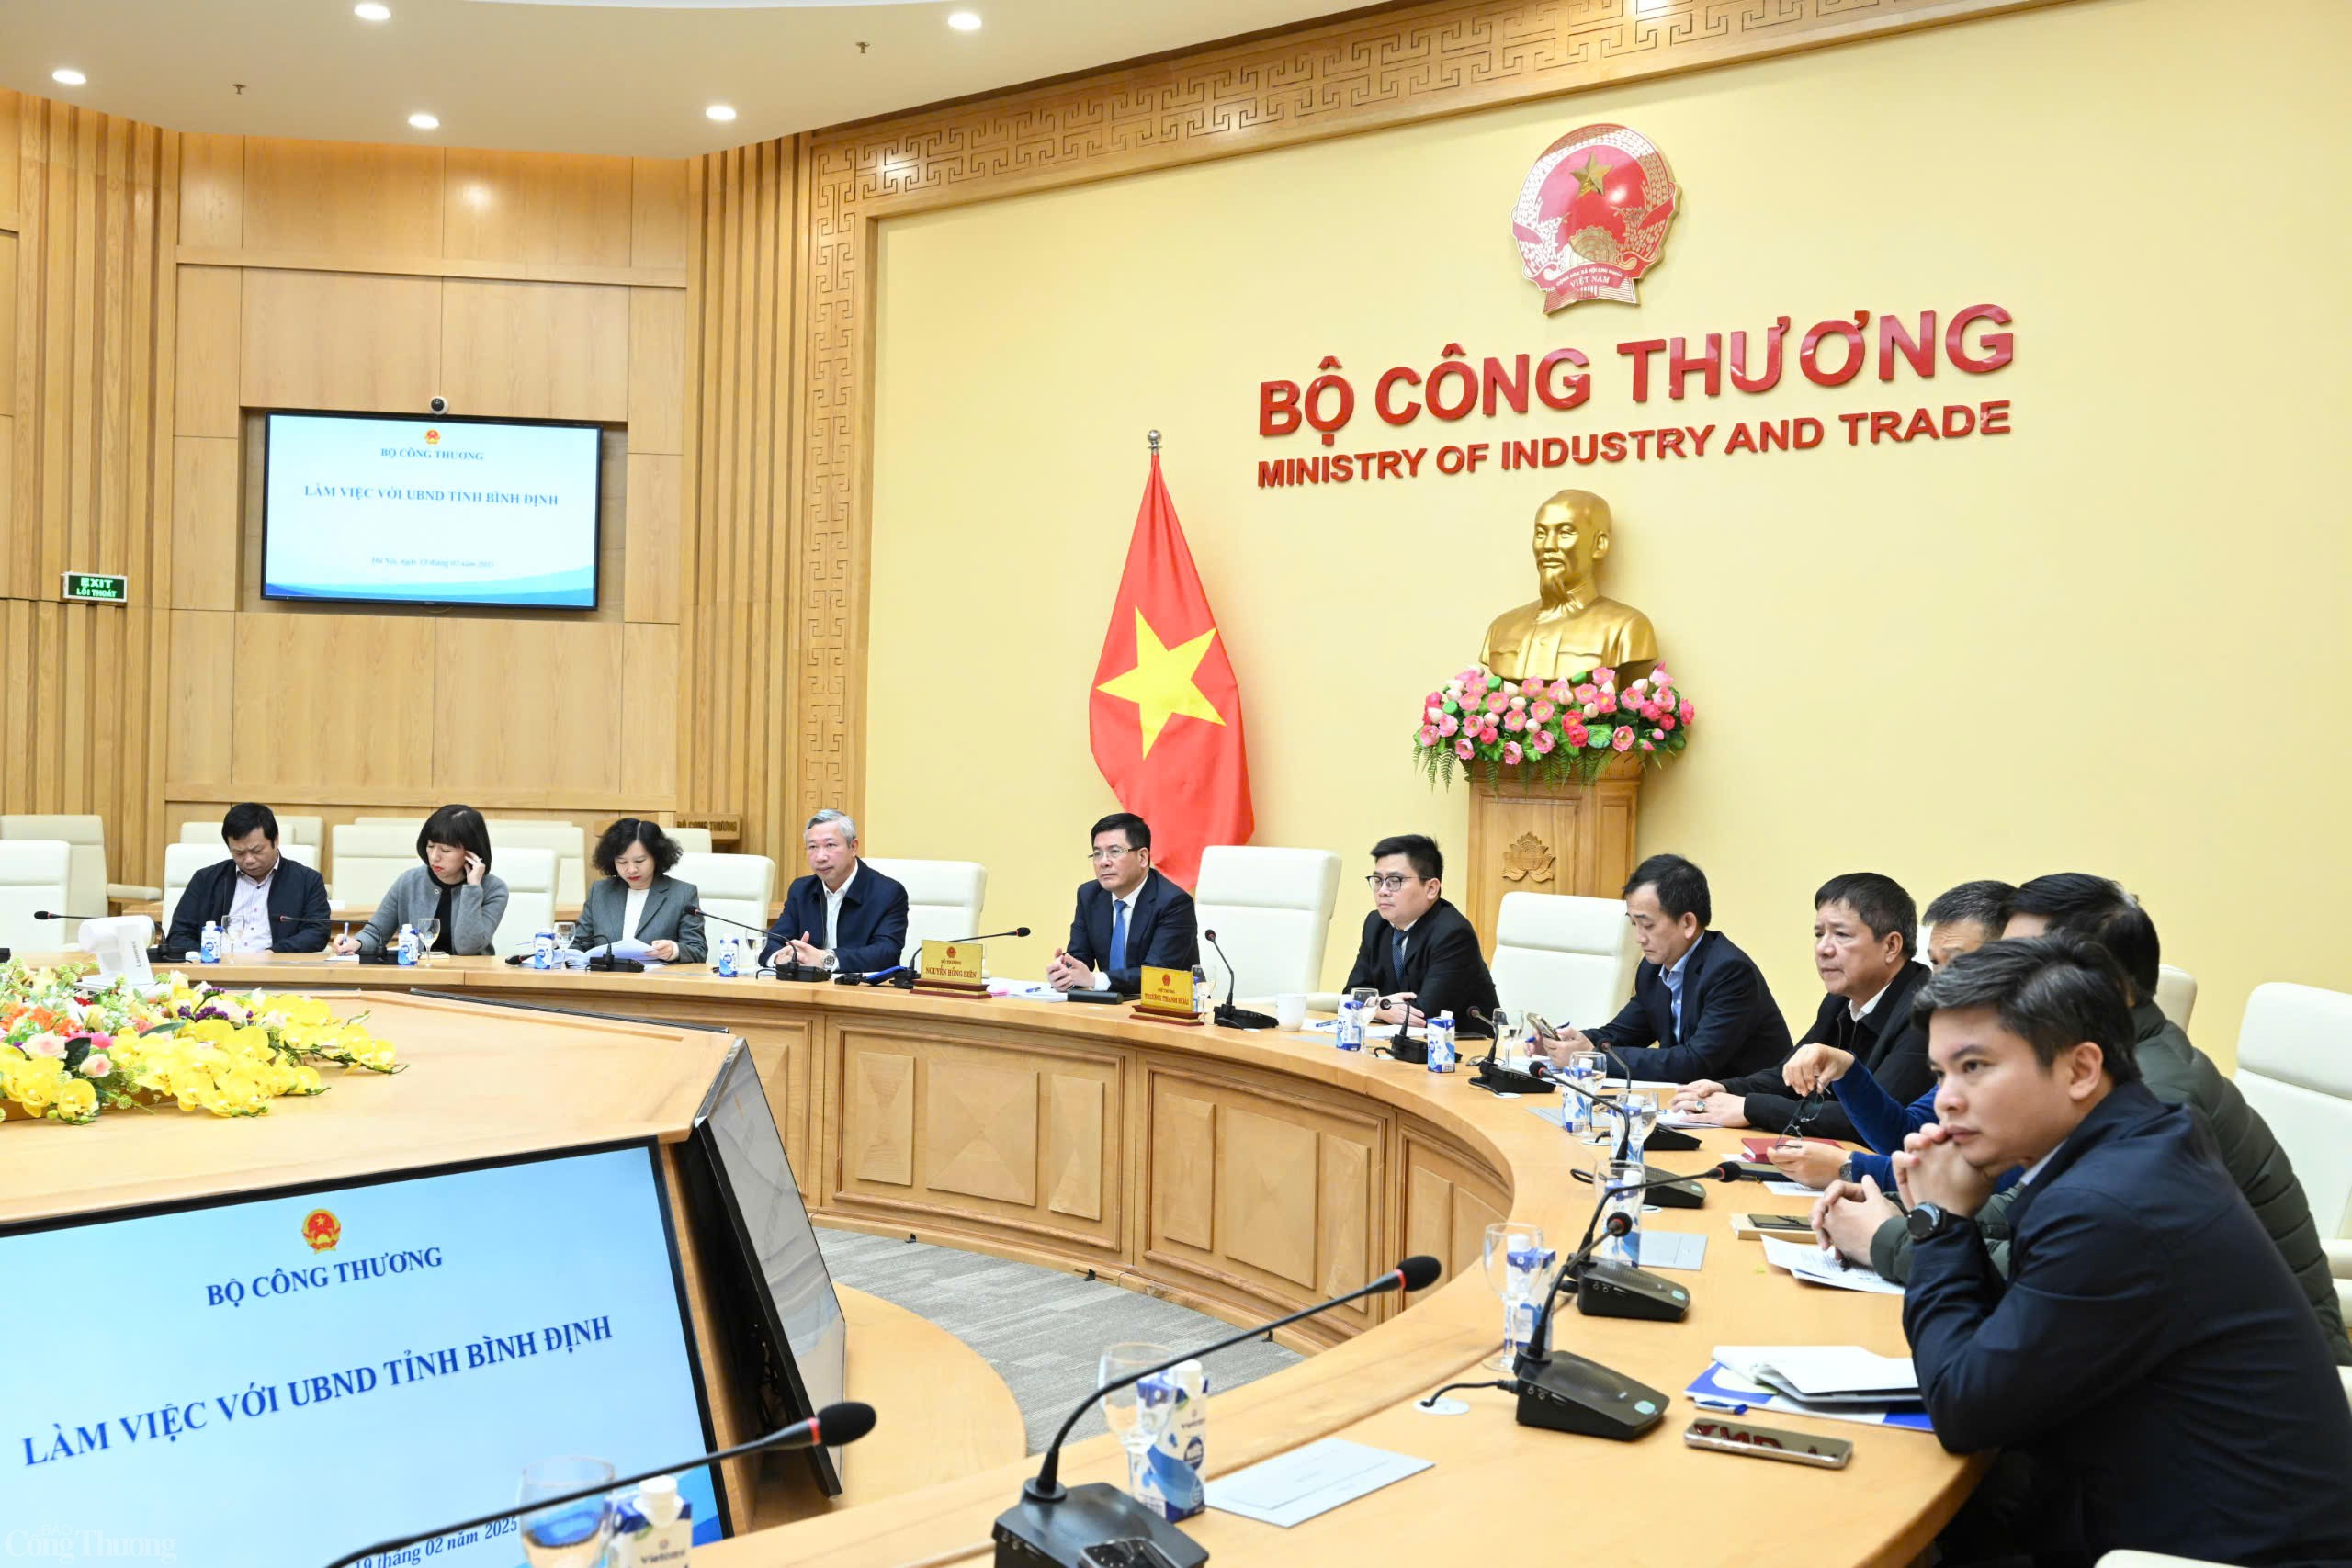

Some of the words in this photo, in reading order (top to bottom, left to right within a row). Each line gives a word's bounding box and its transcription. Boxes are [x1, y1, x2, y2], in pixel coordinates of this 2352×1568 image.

[1570, 275, 1590, 288] VIỆT
[1591, 275, 1611, 285] NAM
[1259, 355, 1355, 446] BỘ
[1374, 342, 1592, 426] CÔNG
[1616, 303, 2016, 402] THƯƠNG
[399, 446, 432, 458] CÔNG
[1257, 446, 1428, 489] MINISTRY
[1436, 442, 1489, 475] OF
[1501, 424, 1716, 470] INDUSTRY
[1724, 417, 1825, 456] AND
[1838, 400, 2012, 446] TRADE
[304, 481, 335, 497] LÀM
[340, 485, 375, 500] VIỆC
[407, 489, 445, 501] UBND
[525, 492, 558, 507] ĐỊNH
[80, 577, 114, 589] EXIT
[92, 587, 118, 598] THOÁT
[925, 964, 947, 976] NGUYỄN
[947, 966, 963, 977] HỒNG
[205, 1278, 245, 1309] BỘ
[252, 1259, 330, 1299] CÔNG
[334, 1245, 443, 1284] THƯƠNG
[22, 1421, 110, 1467] LÀM
[119, 1401, 209, 1444] VIỆC
[215, 1381, 279, 1422] VỚI
[287, 1366, 378, 1407] UBND
[382, 1346, 461, 1387] TỈNH
[465, 1330, 538, 1370] BÌNH
[544, 1314, 614, 1356] ĐỊNH
[377, 1548, 422, 1568] tháng
[425, 1535, 444, 1557] 02
[447, 1529, 479, 1551] năm
[484, 1516, 518, 1540] 2025
